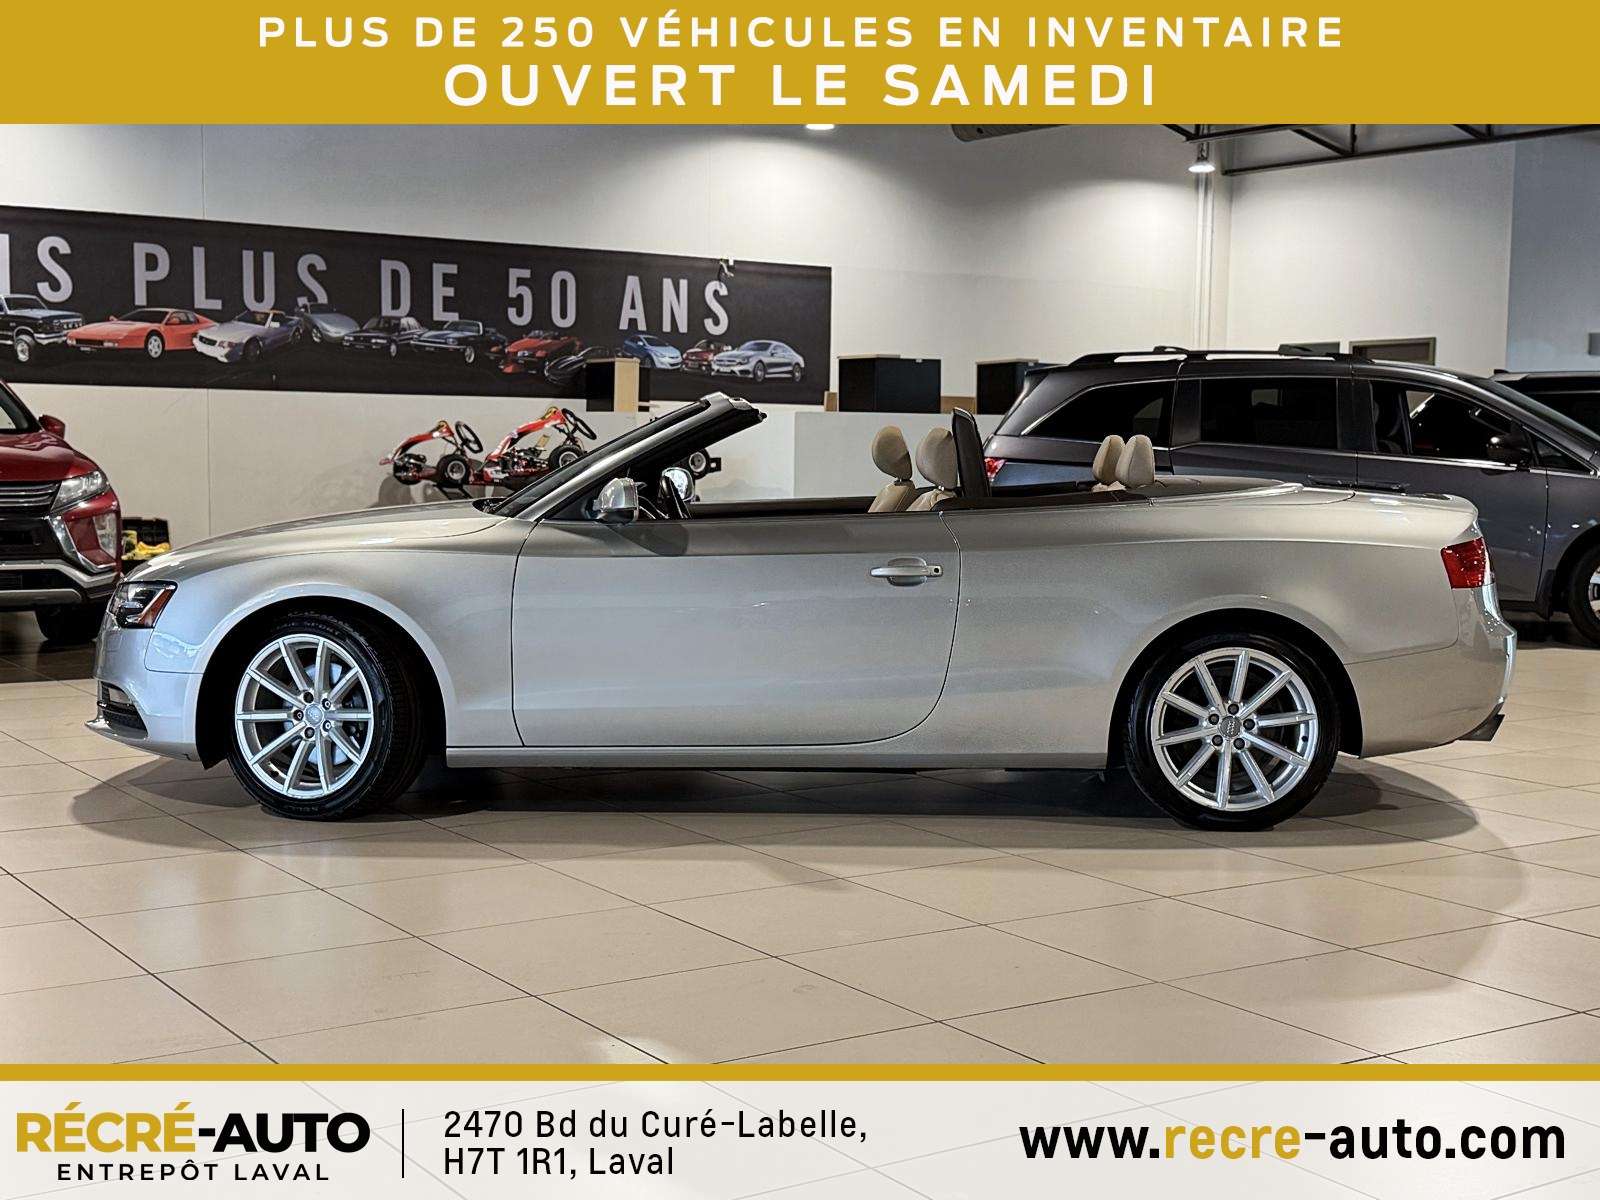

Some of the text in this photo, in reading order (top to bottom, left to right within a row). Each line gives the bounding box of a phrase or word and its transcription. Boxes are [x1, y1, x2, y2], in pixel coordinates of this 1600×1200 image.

[133, 242, 328, 312] PLUS
[381, 259, 459, 322] DE
[507, 268, 576, 328] 50
[619, 275, 729, 336] ANS
